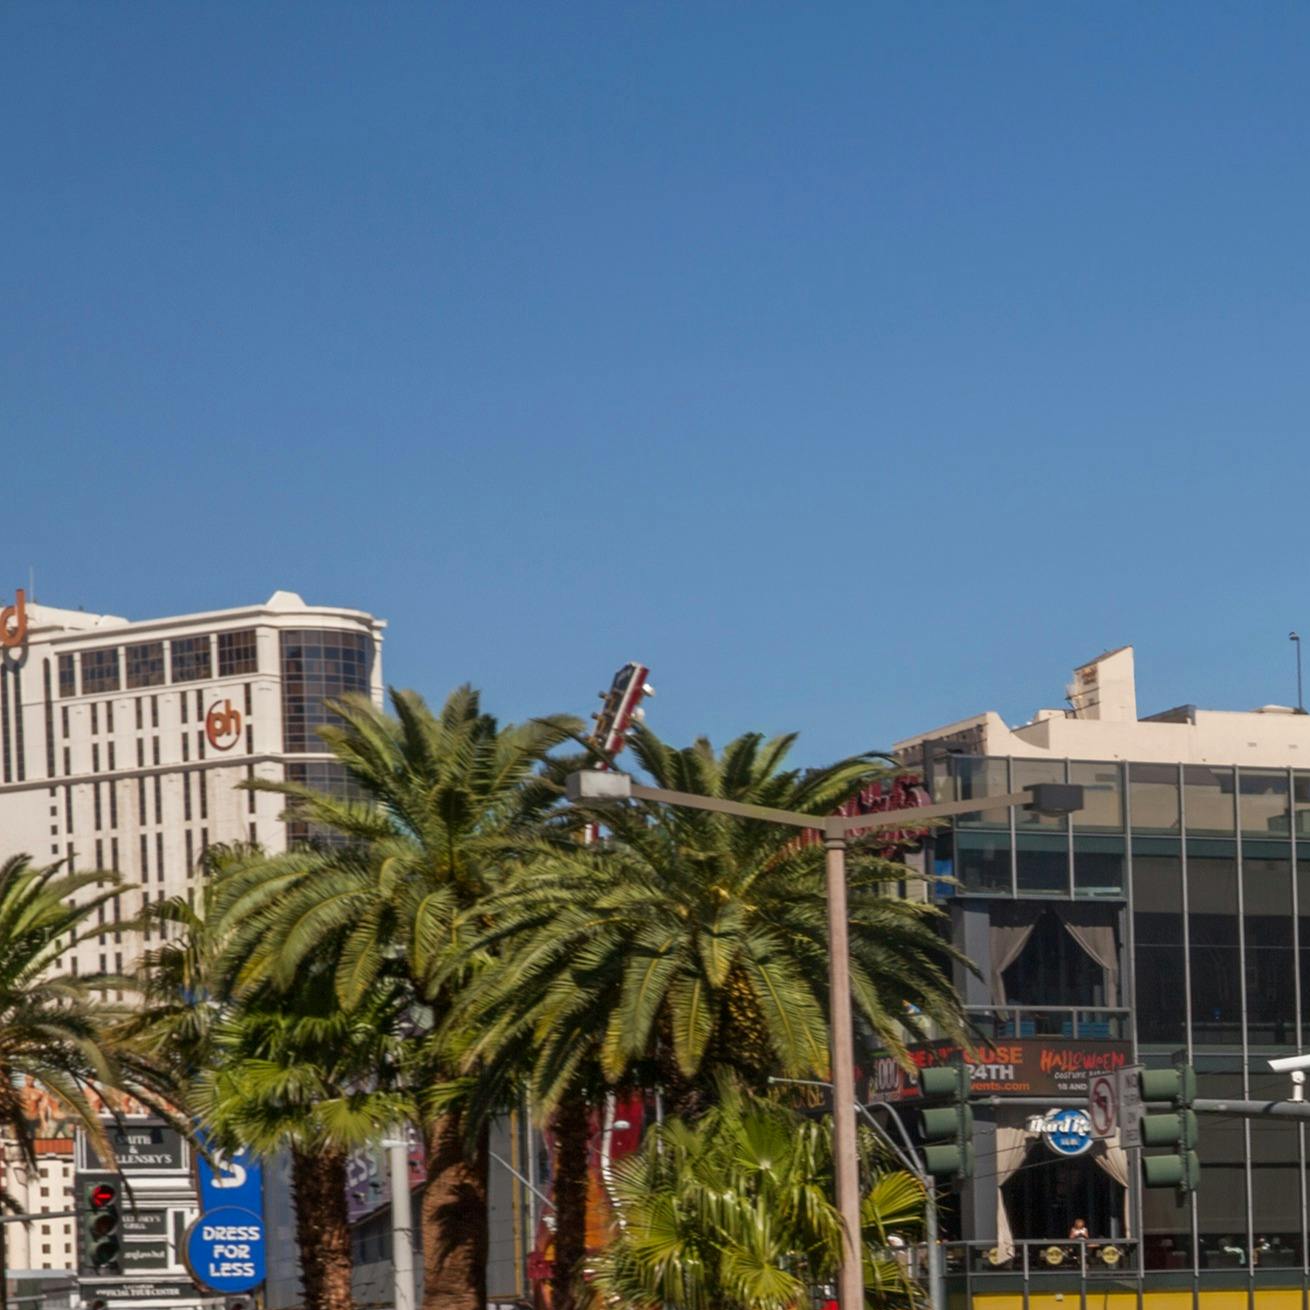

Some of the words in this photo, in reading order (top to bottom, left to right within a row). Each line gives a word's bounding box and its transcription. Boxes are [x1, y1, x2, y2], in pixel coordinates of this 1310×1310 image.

[202, 1226, 261, 1241] DRESS
[213, 1245, 251, 1259] FOR
[208, 1262, 255, 1277] LESS
